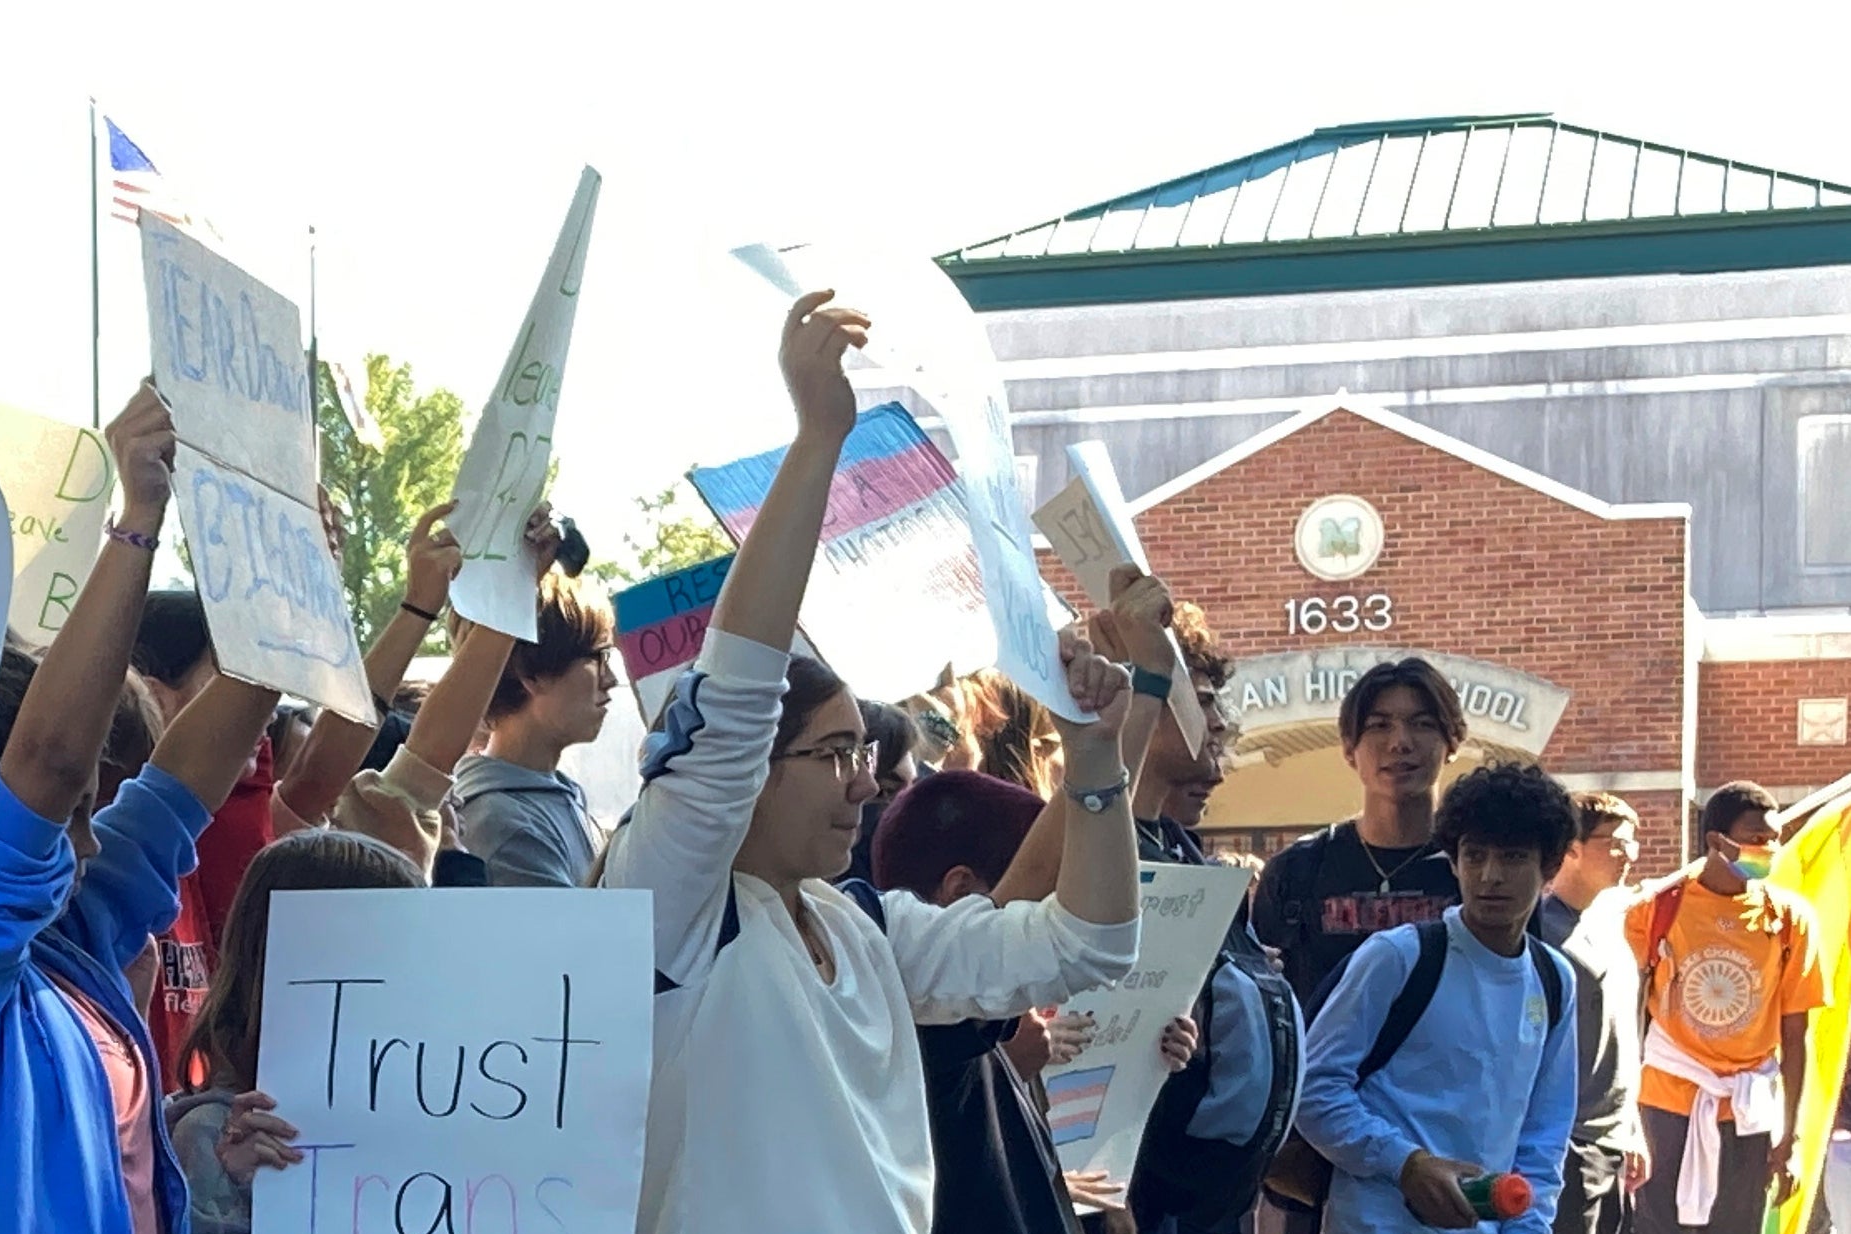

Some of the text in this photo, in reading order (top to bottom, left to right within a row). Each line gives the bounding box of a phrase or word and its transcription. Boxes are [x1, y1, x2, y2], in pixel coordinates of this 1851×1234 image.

[1284, 594, 1393, 635] 1633
[1304, 669, 1358, 702] HIG
[1449, 677, 1528, 731] HOOL
[1141, 888, 1206, 918] rust
[288, 973, 602, 1130] Trust
